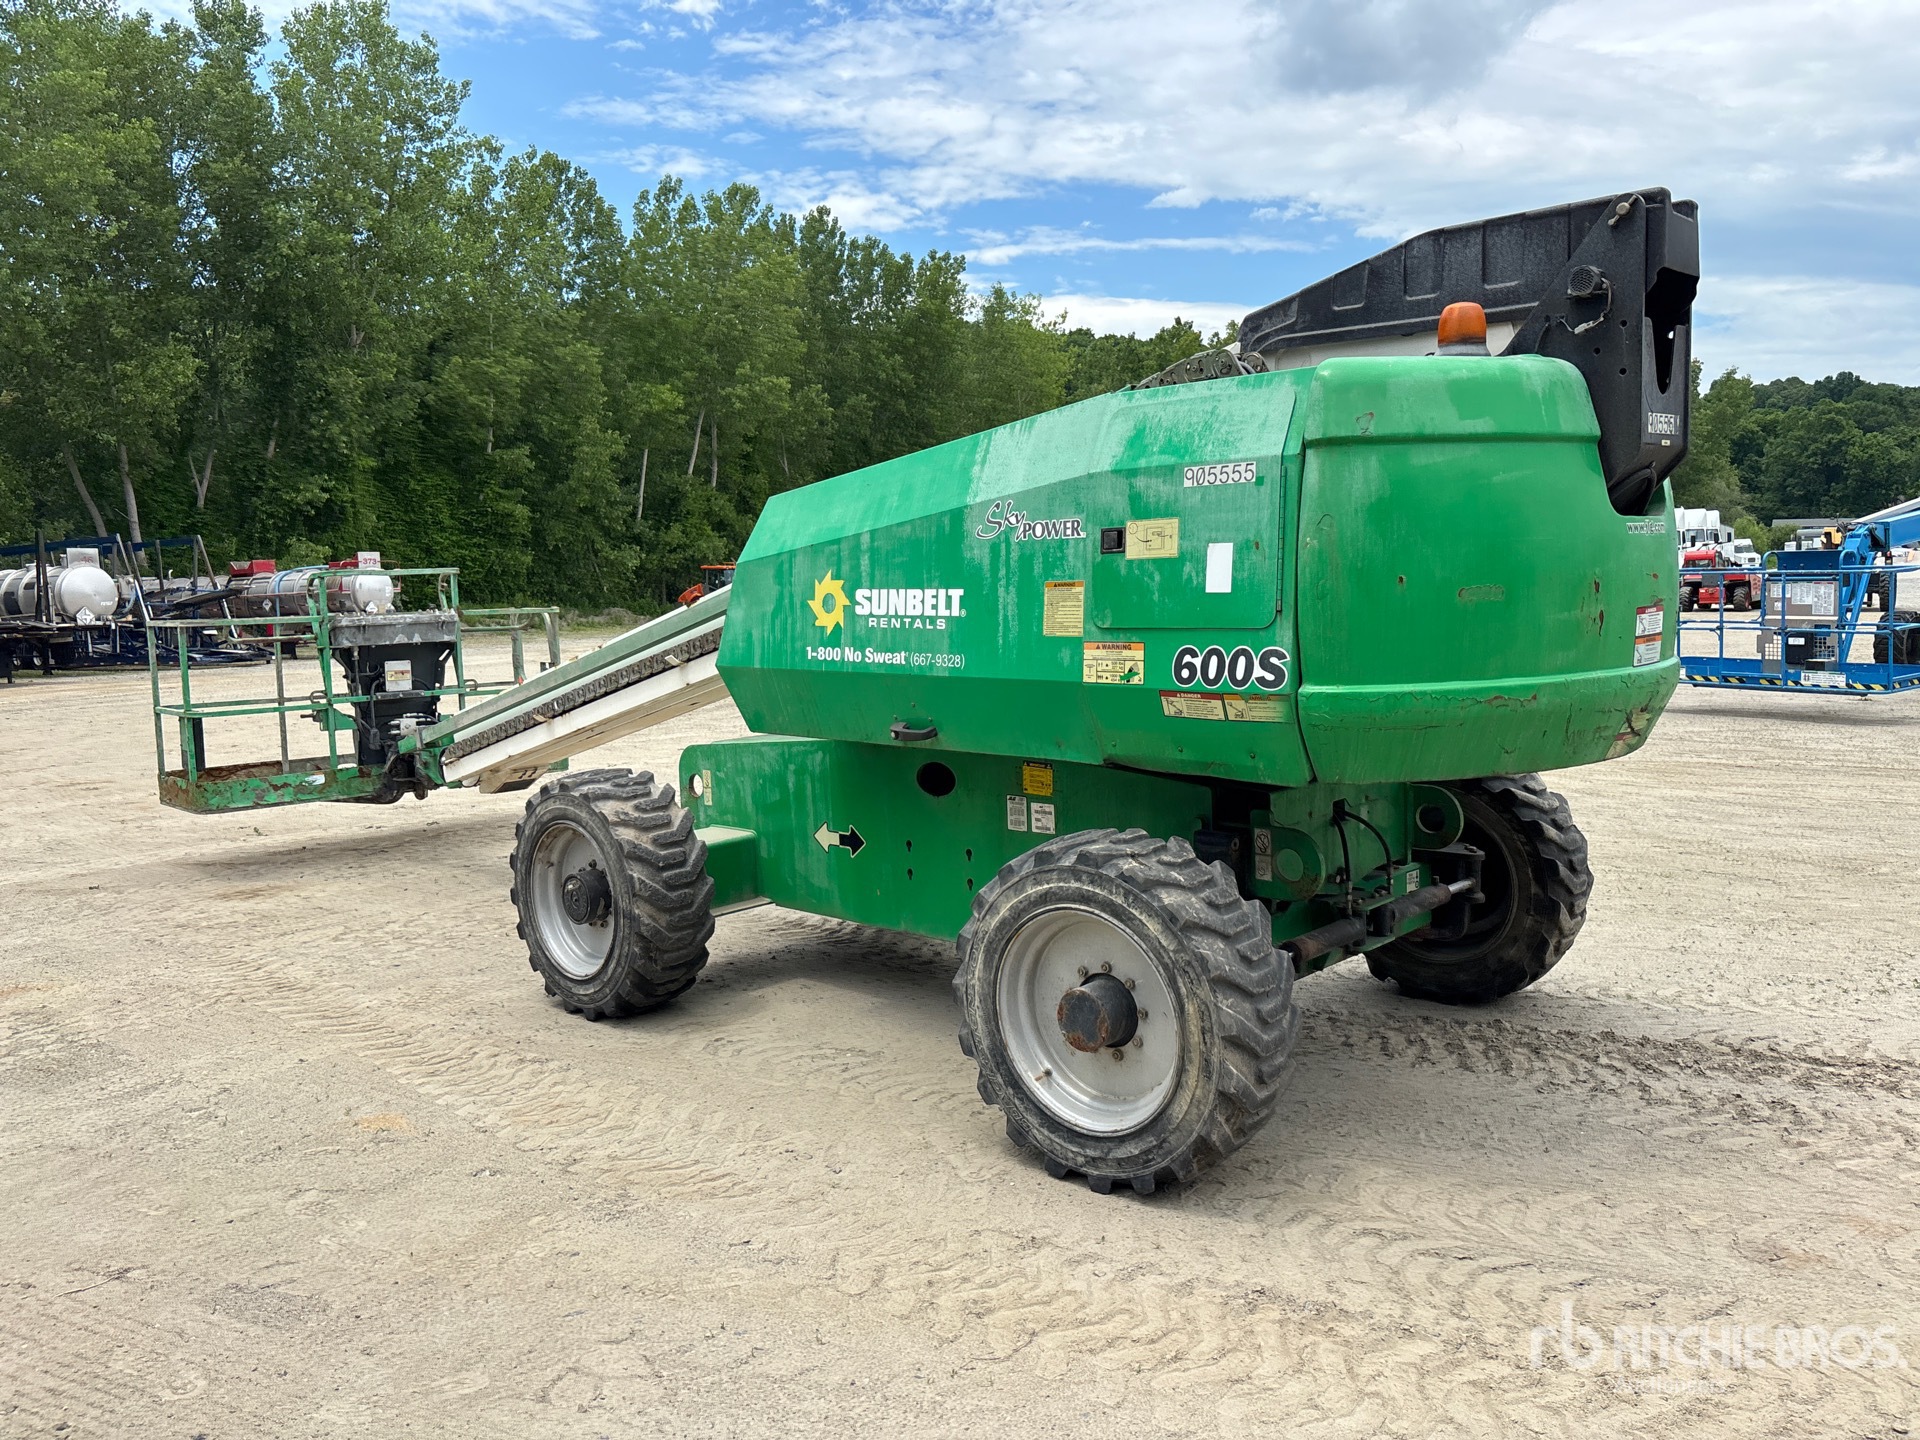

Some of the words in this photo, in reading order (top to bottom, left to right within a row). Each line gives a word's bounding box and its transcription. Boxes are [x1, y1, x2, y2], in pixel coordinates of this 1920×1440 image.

[1648, 412, 1680, 435] 90555
[1184, 462, 1256, 487] 905555
[975, 500, 1026, 542] Sky
[1021, 517, 1082, 541] POWER
[362, 557, 377, 565] 373
[854, 588, 965, 617] SUNBELT
[868, 617, 946, 629] RENTALS
[806, 646, 841, 662] 1-800
[844, 647, 862, 663] No
[865, 647, 906, 665] Sweat
[910, 652, 966, 670] (667-9328)
[1172, 645, 1290, 691] 600S
